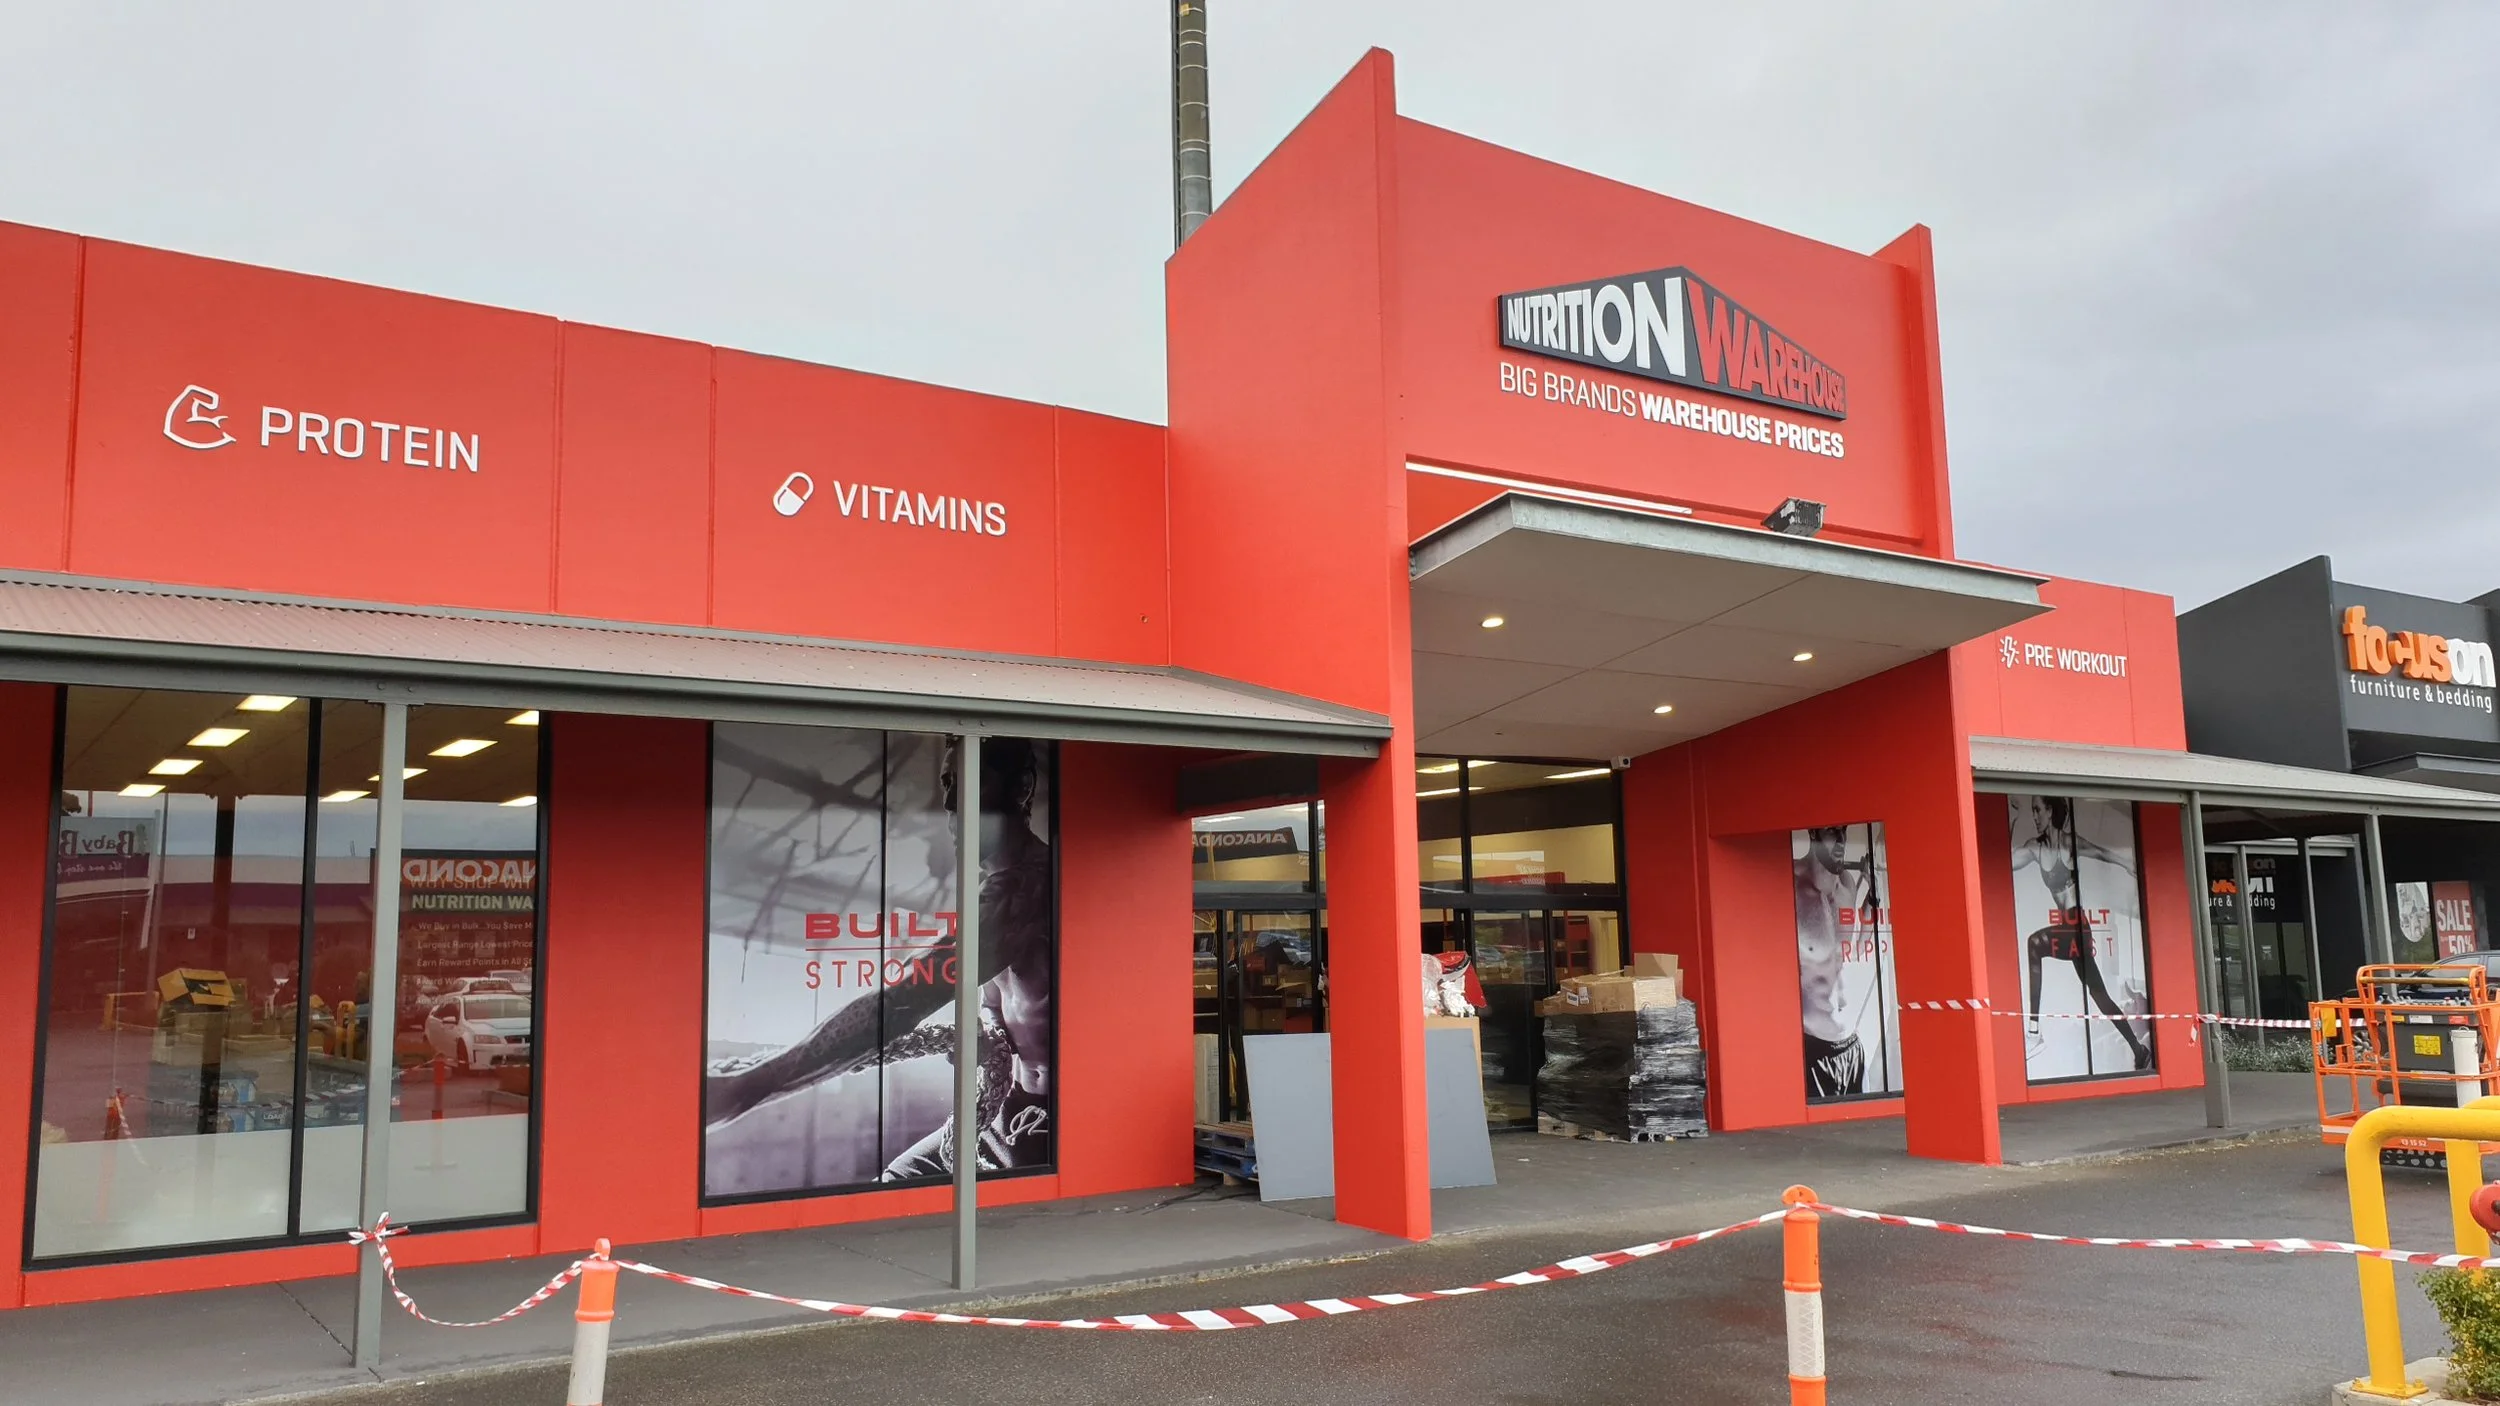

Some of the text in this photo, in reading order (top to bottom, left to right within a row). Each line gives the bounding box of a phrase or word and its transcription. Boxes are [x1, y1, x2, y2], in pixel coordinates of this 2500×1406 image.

[1507, 276, 1845, 413] NUTRITION WAREHOUSE
[1500, 362, 1845, 458] BIG BRANDS WAREHOUSE PRICES
[261, 406, 479, 473] PROTEIN
[833, 480, 1007, 536] VITAMINS
[2025, 643, 2127, 677] PRE WORKOUT
[2350, 675, 2492, 713] furniture & bedding
[412, 895, 502, 910] NUTRITION
[1839, 907, 1891, 925] BUI
[2048, 908, 2110, 925] BUILT
[2437, 899, 2473, 931] SALE
[806, 912, 959, 940] BUILT
[2051, 937, 2113, 959] FAST
[2448, 935, 2475, 955] 50%
[806, 957, 958, 989] STRONG
